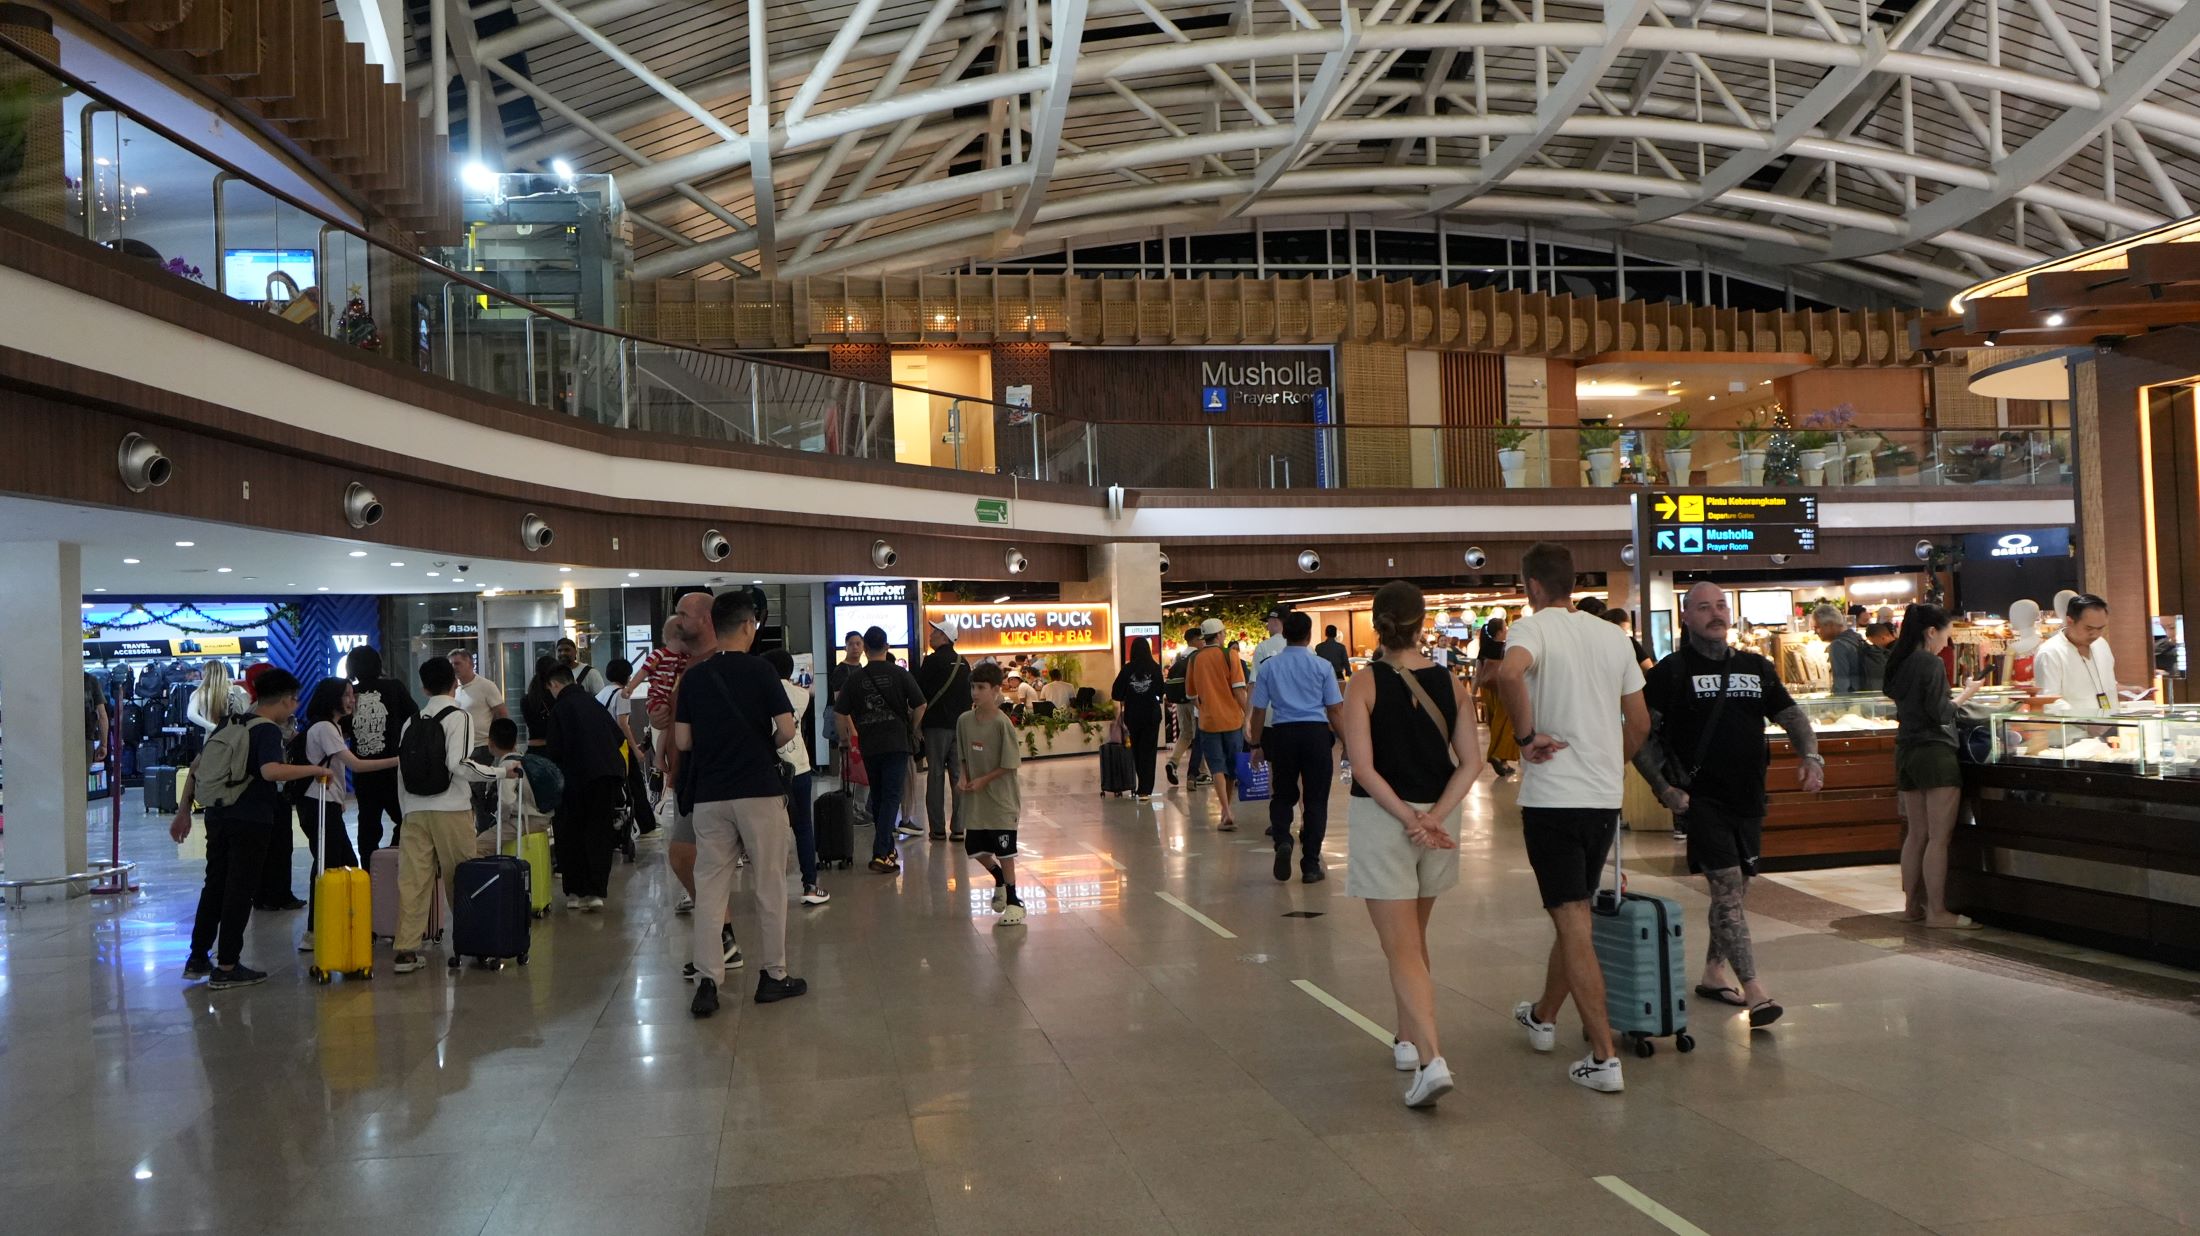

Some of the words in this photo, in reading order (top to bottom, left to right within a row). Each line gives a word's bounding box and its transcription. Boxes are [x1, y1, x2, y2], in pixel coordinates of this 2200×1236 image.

[1201, 361, 1323, 386] Musholla
[1233, 391, 1279, 407] Prayer
[1282, 391, 1315, 404] Roo
[1706, 497, 1727, 506] Pintu
[1728, 497, 1787, 507] Keberangkatan
[1708, 512, 1737, 520] Departure
[1706, 529, 1754, 540] Musholla
[1706, 543, 1728, 552] Prayer
[1729, 543, 1749, 551] Room
[839, 586, 862, 597] BALI
[863, 584, 906, 596] AIRPORT
[944, 612, 1037, 630] WOLFGANG
[1046, 610, 1093, 628] PUCK
[1000, 630, 1054, 645] KITCHEN
[1066, 629, 1092, 643] BAR
[113, 648, 162, 656] ACCESSORIES
[1697, 675, 1761, 690] GUESS
[1725, 691, 1762, 699] NGELES
